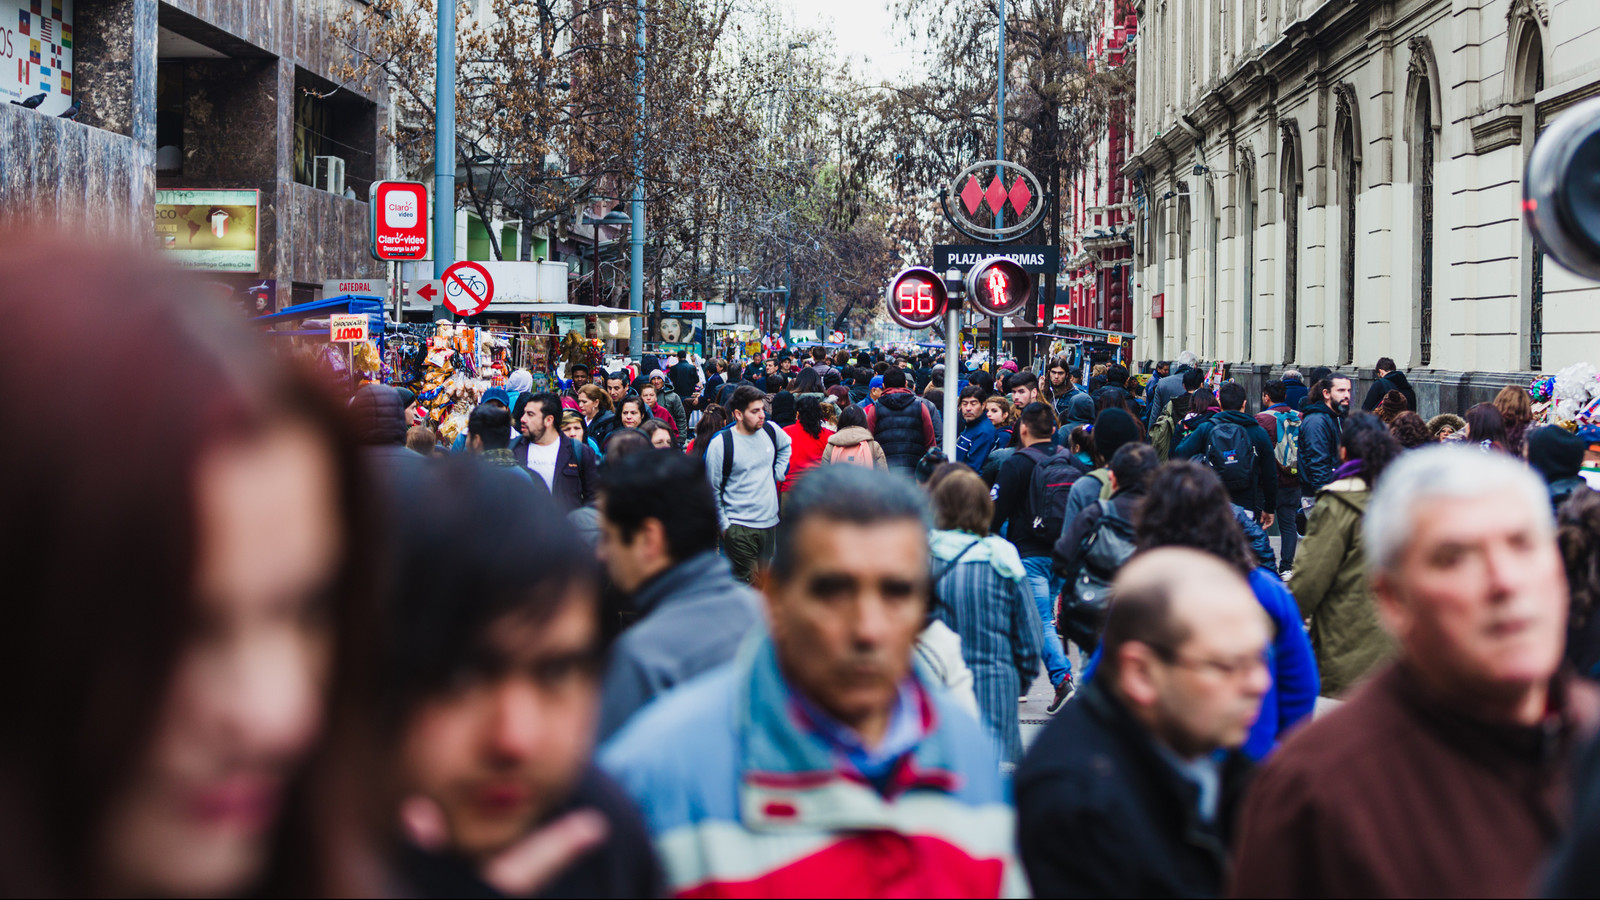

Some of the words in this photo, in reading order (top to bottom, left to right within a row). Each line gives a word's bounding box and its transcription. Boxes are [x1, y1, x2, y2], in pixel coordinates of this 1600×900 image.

[948, 253, 982, 265] PLAZA
[339, 282, 371, 292] CATEDRAL
[899, 283, 933, 313] 56
